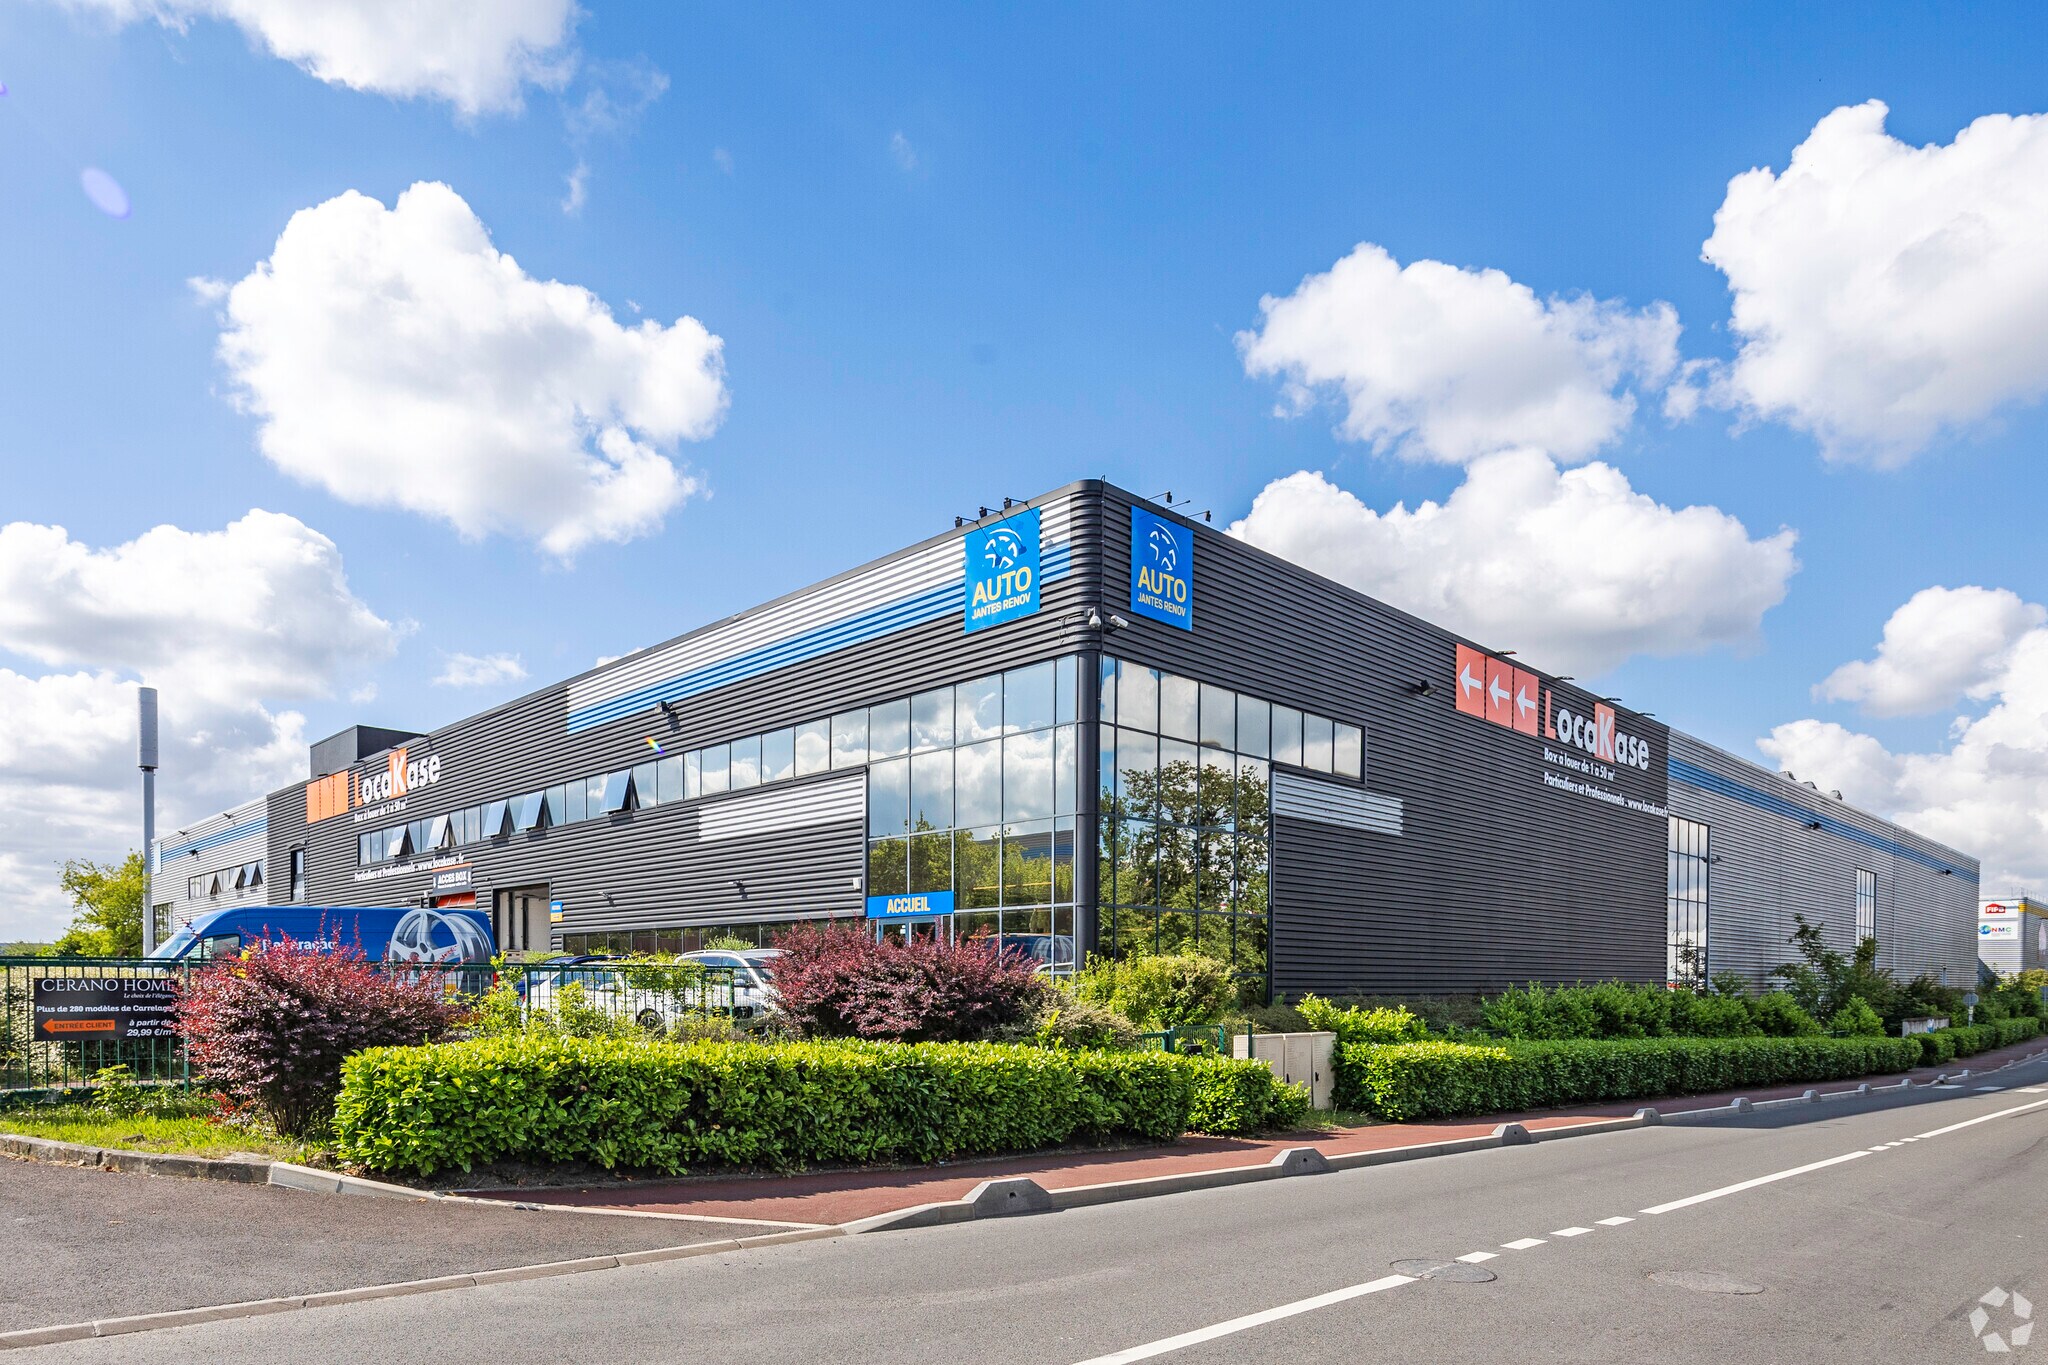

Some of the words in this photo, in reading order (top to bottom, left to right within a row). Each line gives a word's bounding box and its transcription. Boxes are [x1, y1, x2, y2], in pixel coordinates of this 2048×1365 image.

[972, 566, 1032, 607] AUTO
[1138, 566, 1186, 603] AUTO
[972, 601, 1002, 620] JANTES
[1003, 592, 1031, 610] RENOV
[1138, 592, 1163, 610] JANTES
[1164, 601, 1186, 616] RENOV
[1545, 689, 1649, 770] LocaKase
[1544, 747, 1558, 764] Box
[1559, 751, 1564, 764] à
[1564, 753, 1580, 770] louer
[1581, 759, 1589, 773] de
[1590, 762, 1594, 775] 1
[1600, 765, 1607, 779] 50
[354, 754, 441, 807] LocaKase
[1544, 772, 1578, 793] Particuliers
[1578, 784, 1585, 794] et
[1585, 784, 1625, 806] Professionnels
[438, 872, 455, 884] ACCES
[455, 871, 467, 881] BOX
[887, 896, 931, 914] ACCUEIL
[41, 979, 118, 991] CERANO
[124, 979, 174, 991] HOME
[127, 1029, 152, 1037] 29,99
[136, 1019, 160, 1027] partir
